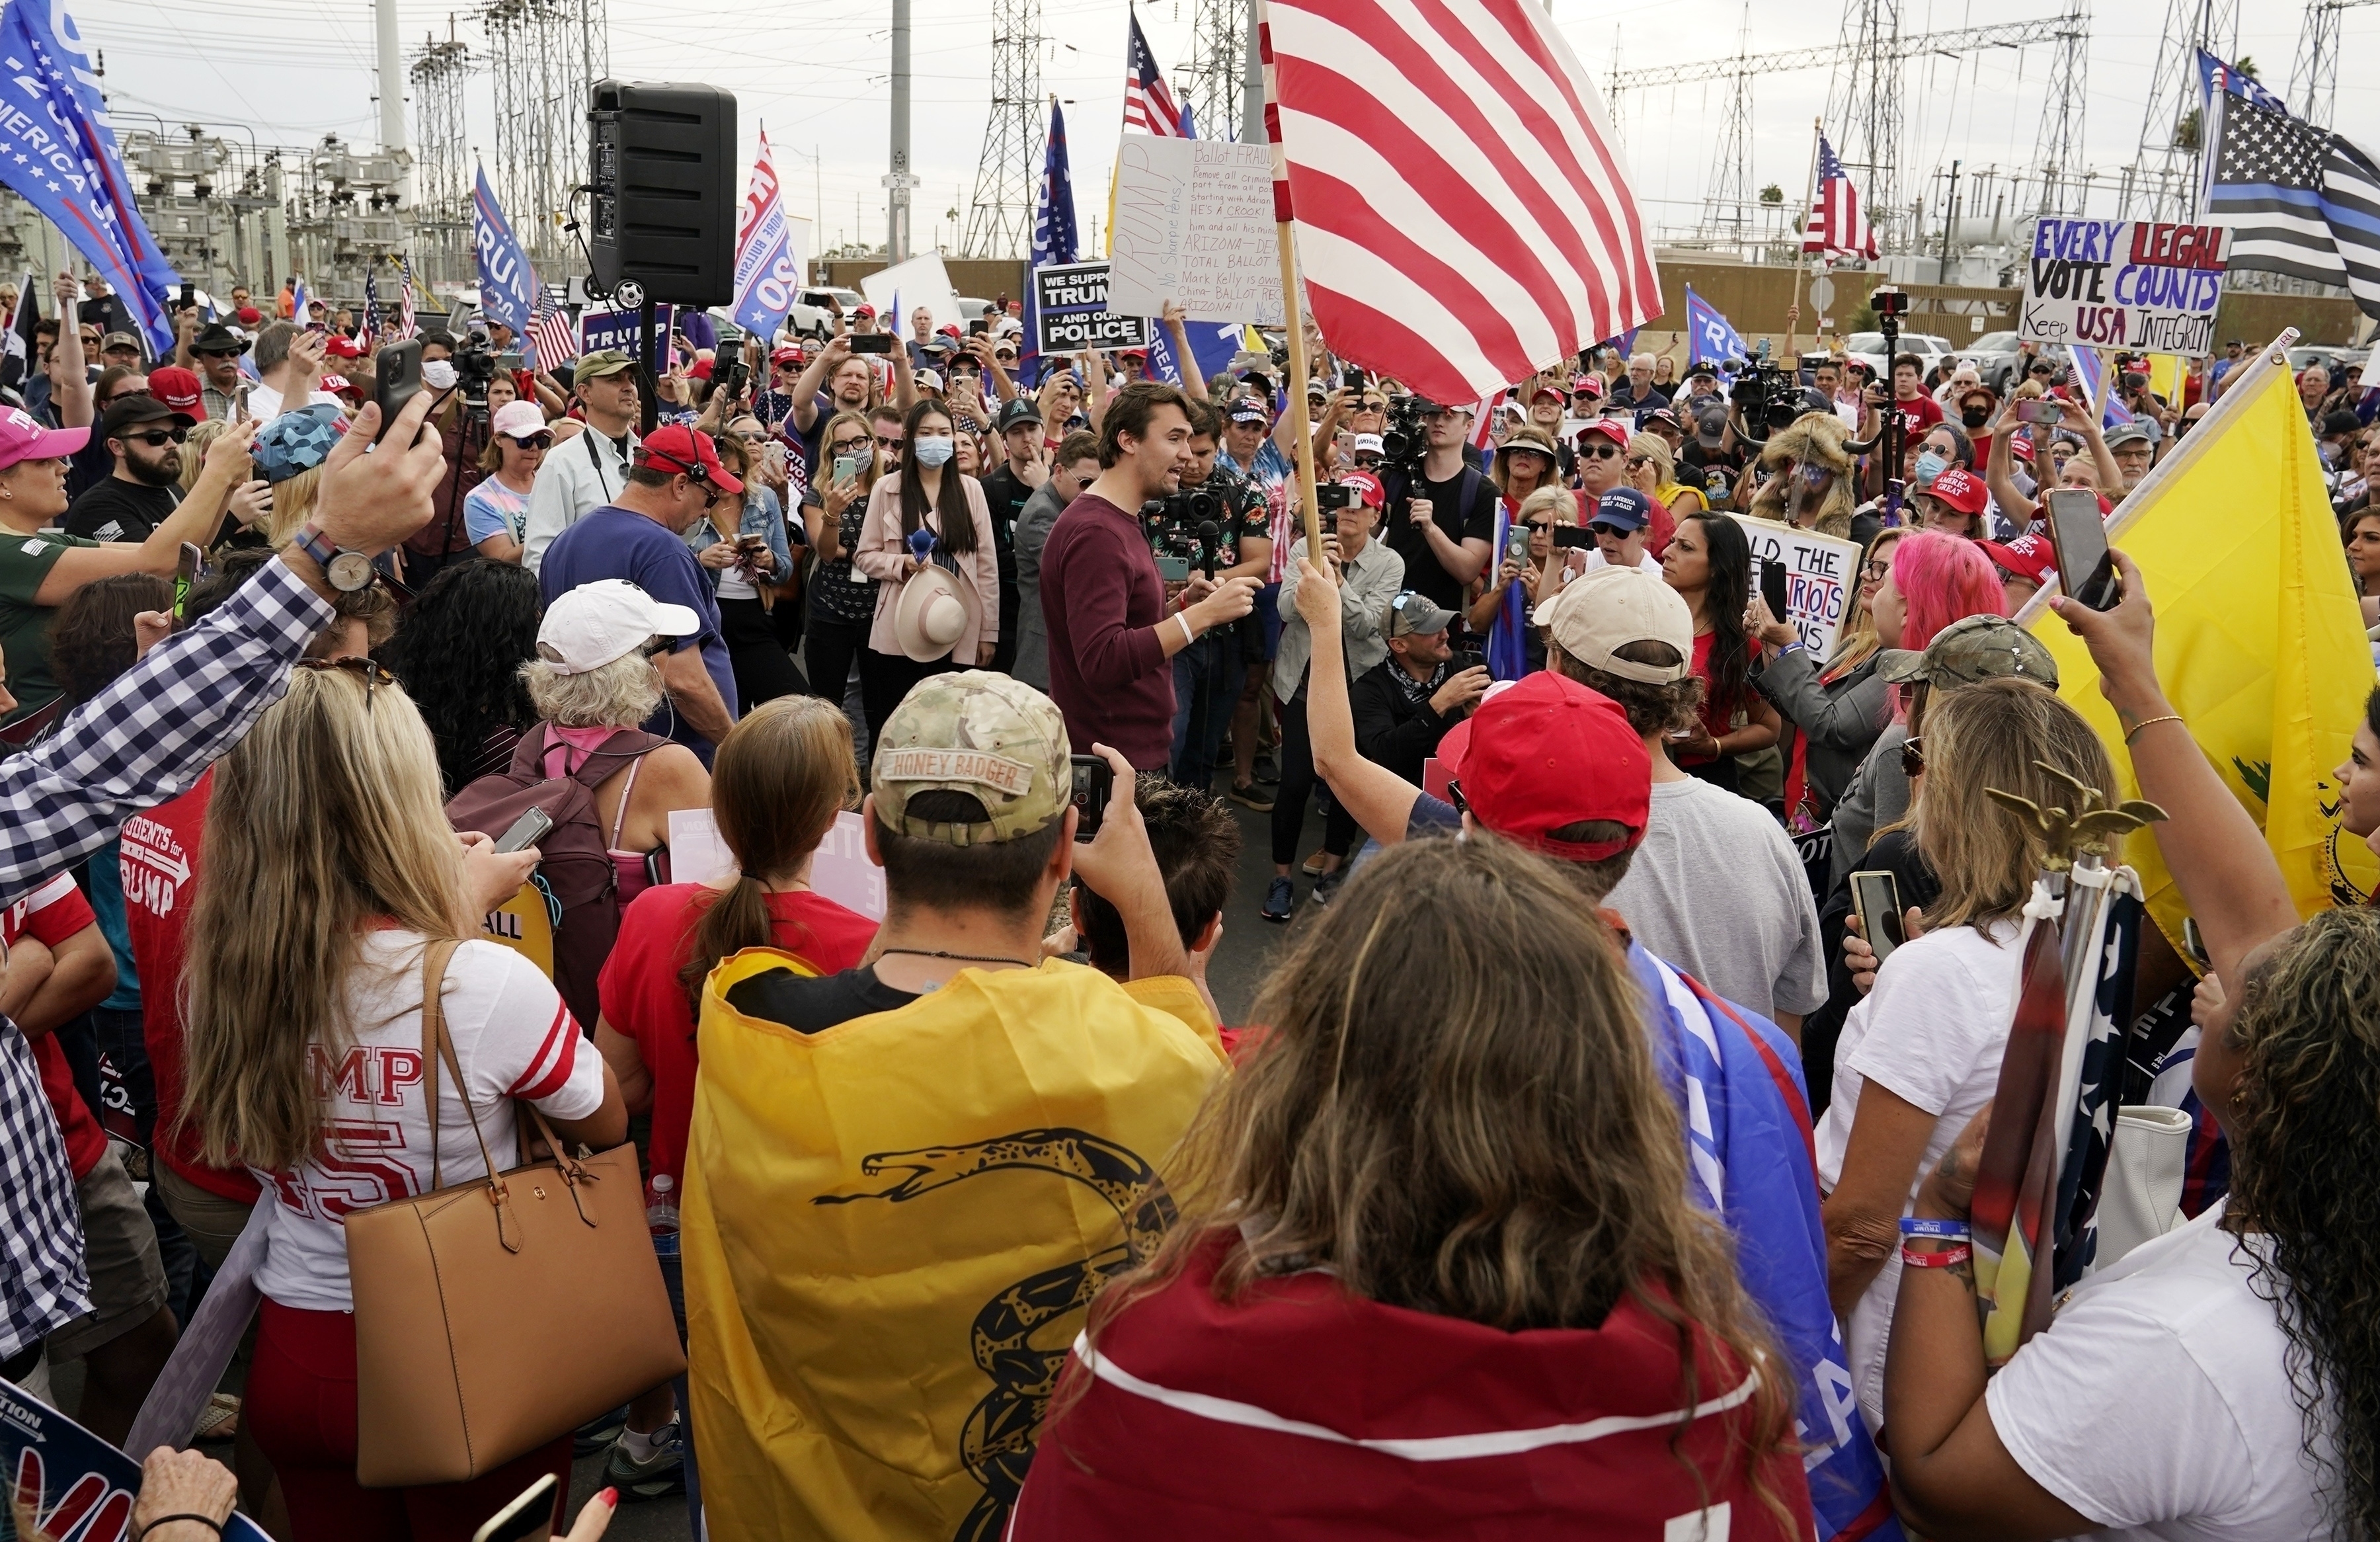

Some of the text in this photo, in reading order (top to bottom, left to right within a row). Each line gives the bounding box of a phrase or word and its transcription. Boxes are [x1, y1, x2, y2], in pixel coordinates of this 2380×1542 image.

[1195, 142, 1271, 165] Ballot FRAU
[1193, 167, 1271, 184] Remove all crimina
[1193, 181, 1212, 192] part
[1218, 181, 1239, 190] from
[1191, 194, 1224, 205] starting
[1113, 142, 1171, 293] TRUMP
[1191, 206, 1212, 216] HE'S
[1190, 219, 1205, 231] him
[1226, 223, 1238, 232] all
[1243, 224, 1255, 233] his
[1161, 220, 1180, 265] Sharpie
[2034, 219, 2228, 271] EVERY LEGAL
[1181, 255, 1219, 268] TOTAL
[1228, 255, 1271, 268] BALLOT
[1045, 276, 1066, 287] WE
[1158, 272, 1176, 288] No
[1181, 271, 1210, 284] Mark
[1216, 272, 1242, 286] Kelly
[1258, 277, 1283, 286] owne
[2032, 257, 2225, 311] VOTE COUNTS
[1216, 287, 1257, 300] BALLOT
[1062, 313, 1090, 324] AND
[2022, 301, 2217, 352] Keep USA INTEGRITY
[1050, 321, 1137, 343] POLICE
[1700, 355, 1720, 366] KEE
[1357, 438, 1378, 446] Woke
[1948, 470, 1969, 481] KEEP
[1936, 483, 1963, 497] GREAT
[1937, 476, 1971, 493] AMERICA
[1612, 495, 1636, 507] AMERICA
[1614, 502, 1633, 511] AGAIN
[1794, 546, 1840, 575] THE
[1786, 573, 1843, 619] TRIOTS
[893, 754, 1018, 787] HONEY BADGER
[123, 816, 183, 857] UDENTS for
[120, 859, 174, 919] RUMP
[307, 1043, 423, 1107] MP
[0, 1395, 42, 1430] TION
